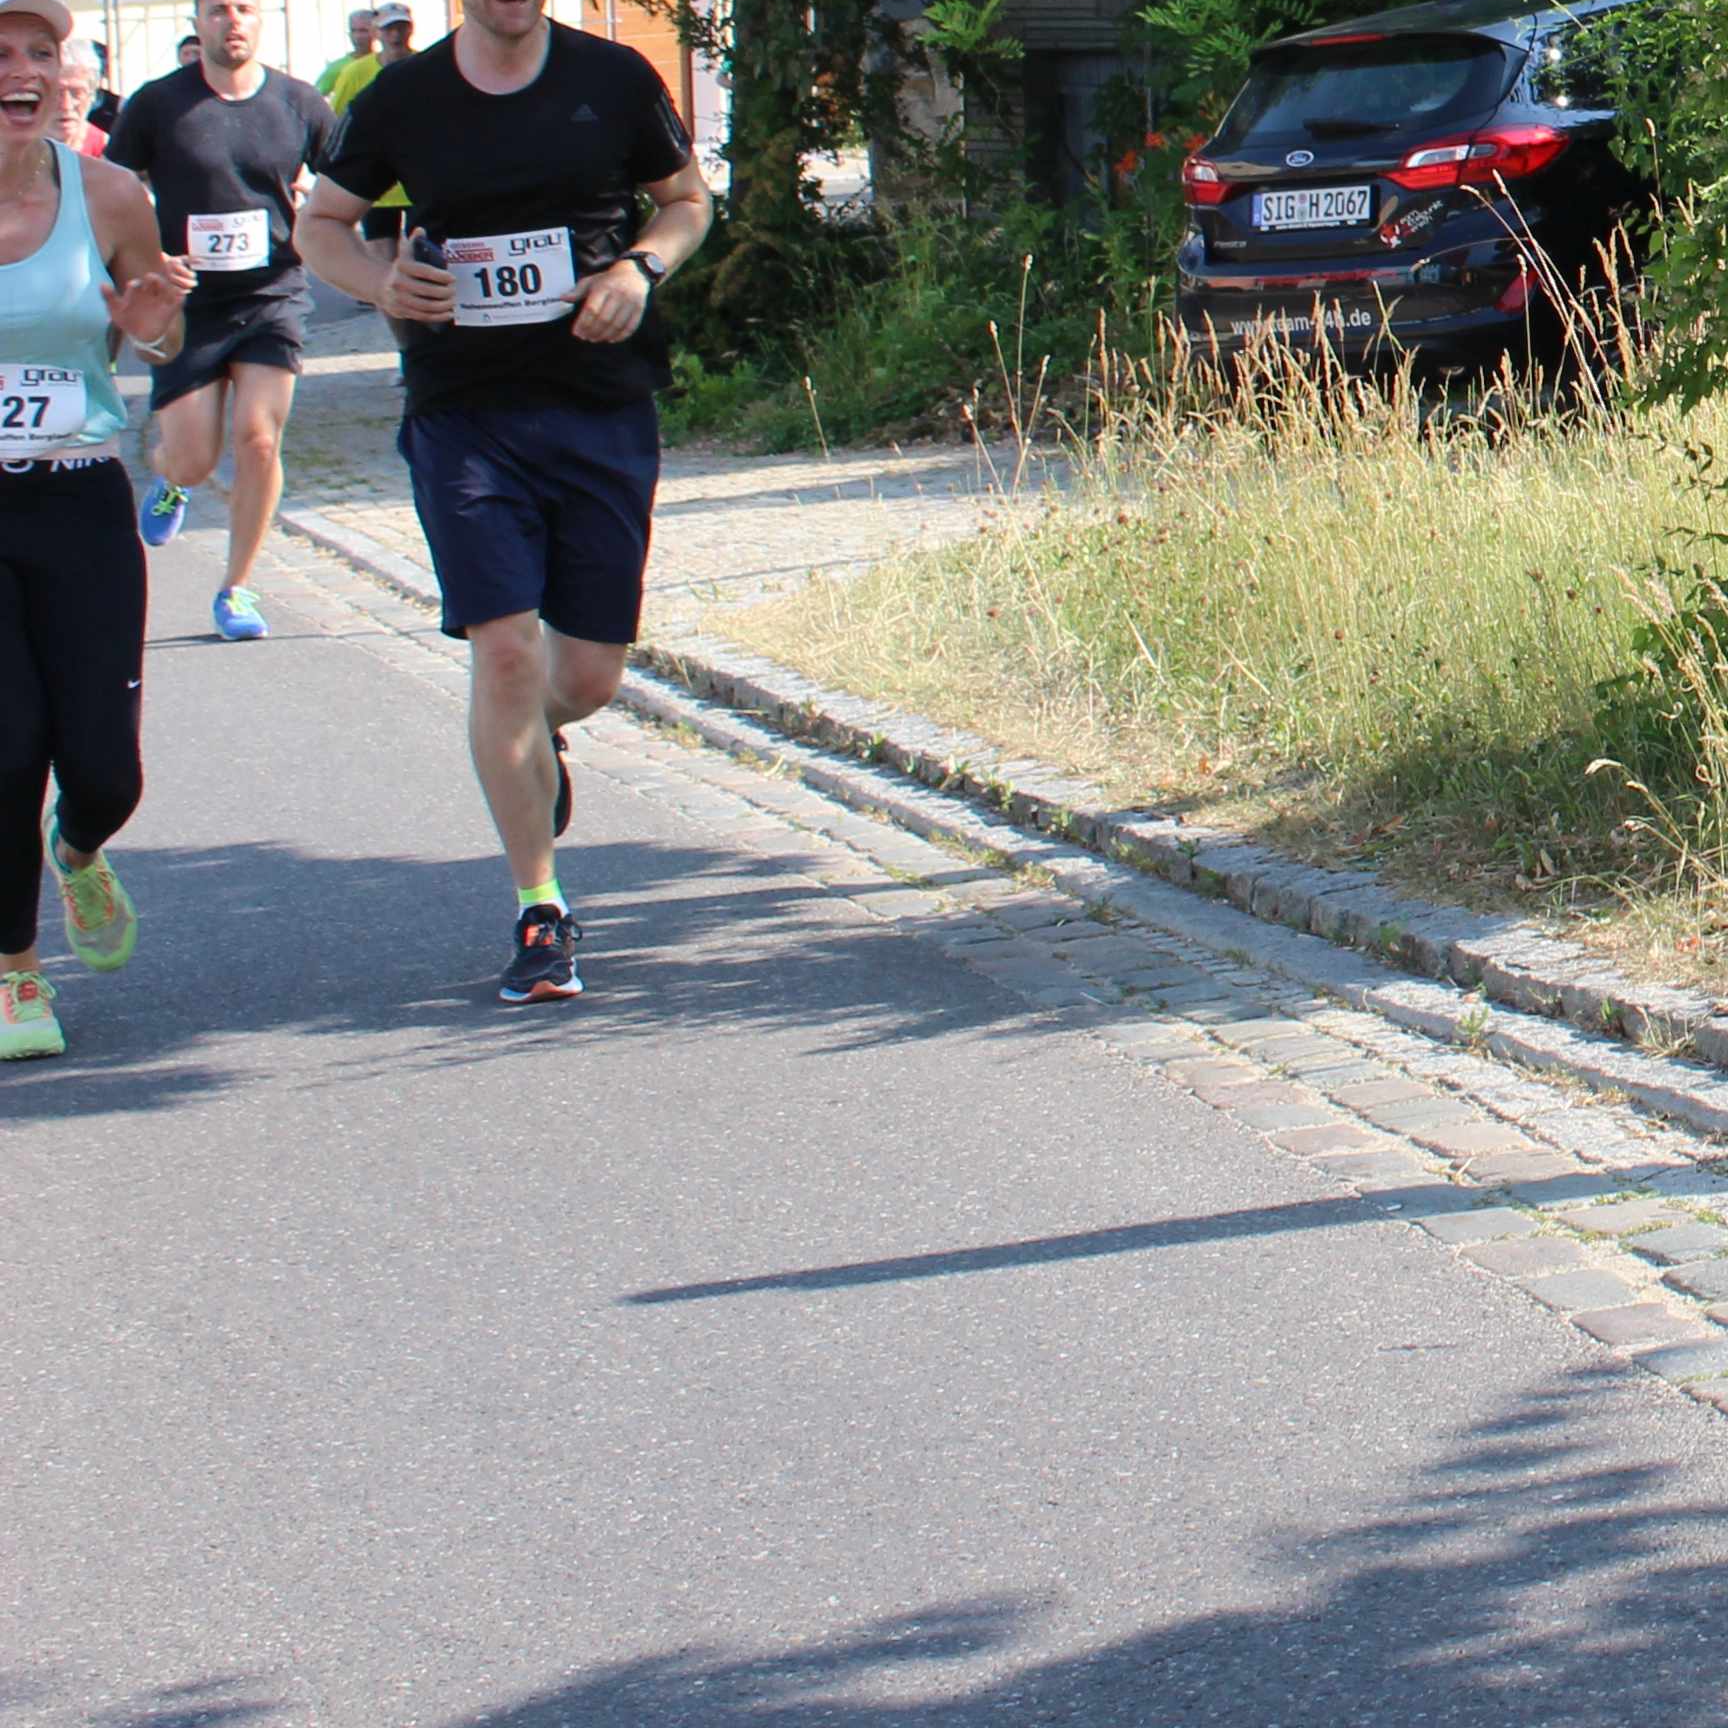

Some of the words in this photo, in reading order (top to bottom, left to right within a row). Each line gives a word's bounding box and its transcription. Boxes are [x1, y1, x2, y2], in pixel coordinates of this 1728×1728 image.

[1263, 194, 1296, 222] SIG
[1308, 193, 1321, 219] H
[1323, 190, 1368, 218] 2067
[207, 232, 250, 254] 273
[473, 263, 542, 299] 180
